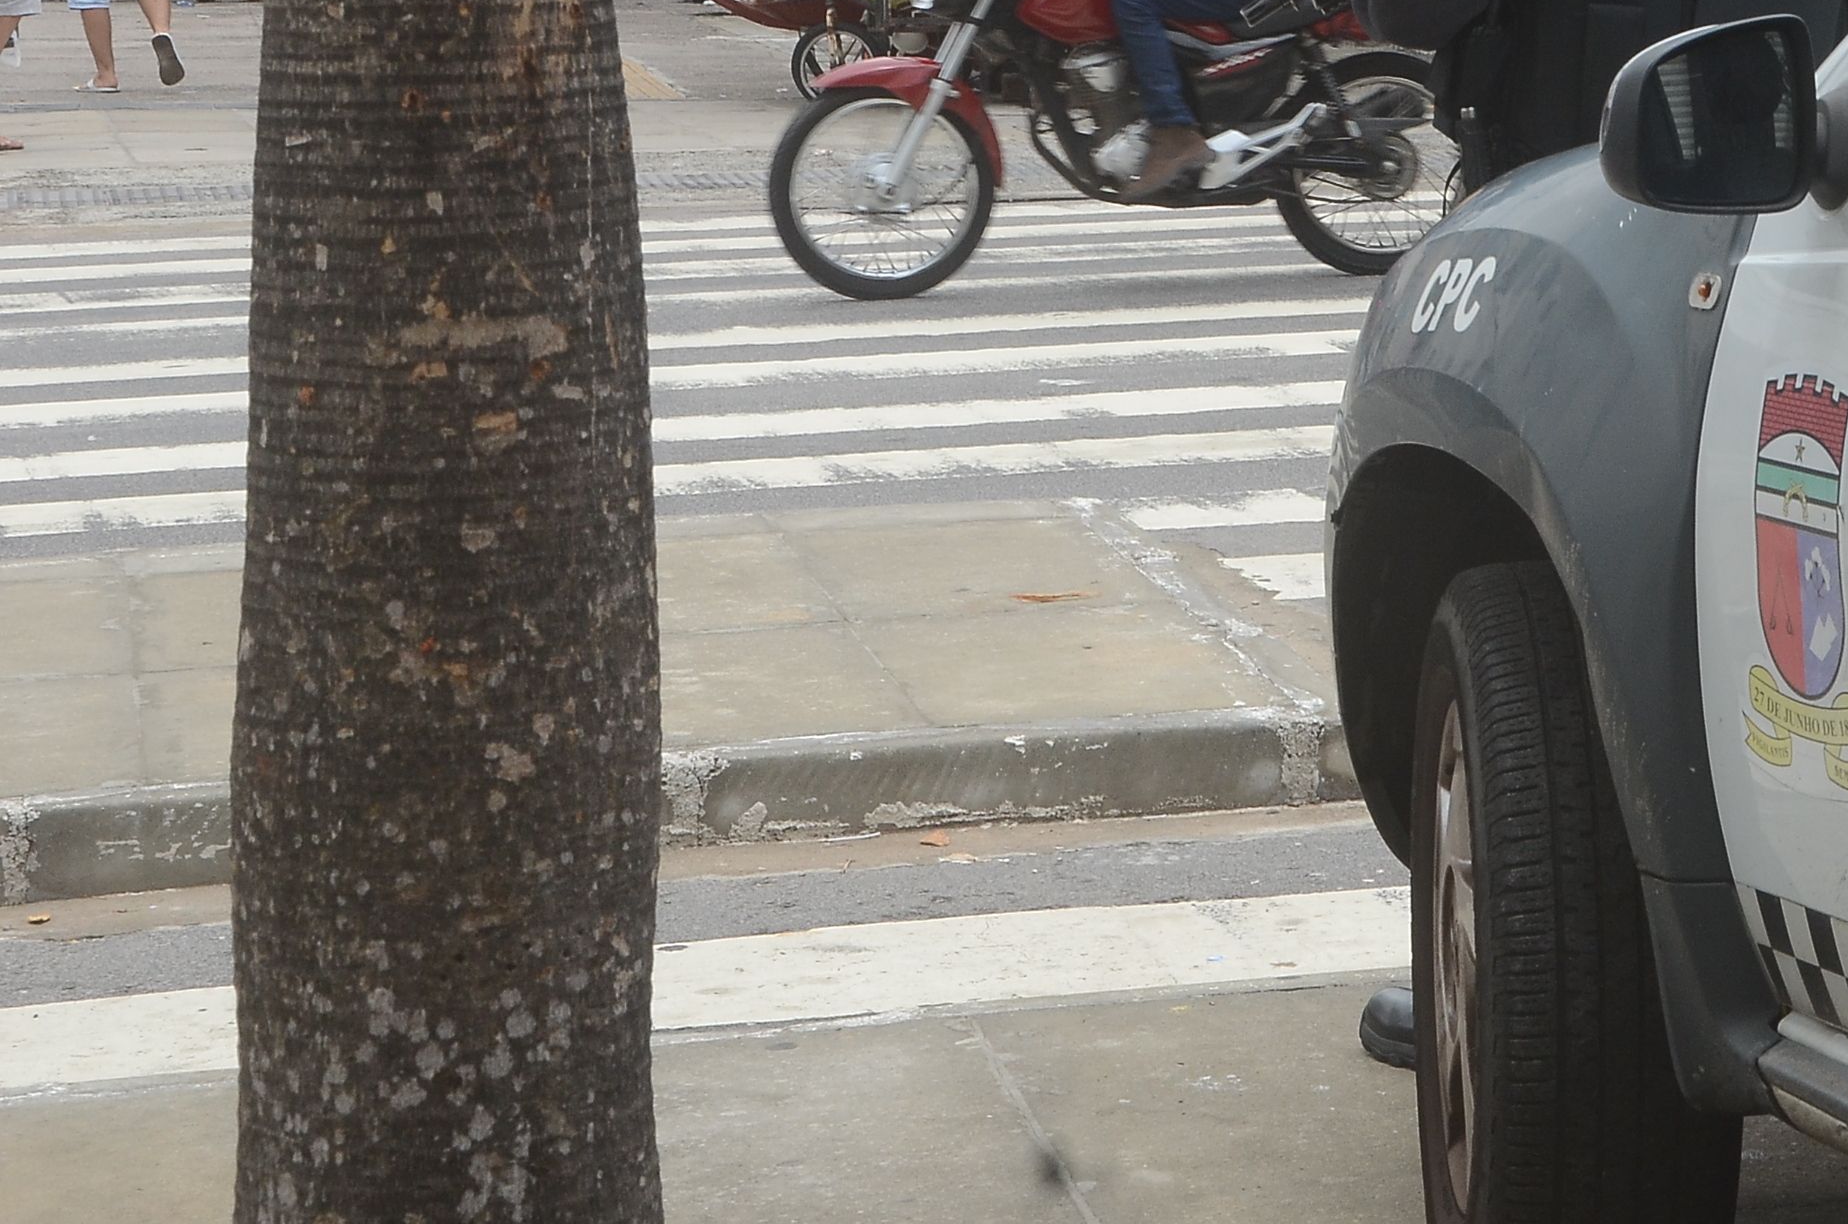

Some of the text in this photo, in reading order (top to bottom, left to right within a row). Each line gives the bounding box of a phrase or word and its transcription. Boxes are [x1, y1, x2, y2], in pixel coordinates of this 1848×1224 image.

[1410, 256, 1497, 334] CPC
[1753, 686, 1765, 707] 27
[1766, 697, 1781, 720] DE
[1783, 707, 1820, 735] JUNHO
[1823, 721, 1838, 737] DE
